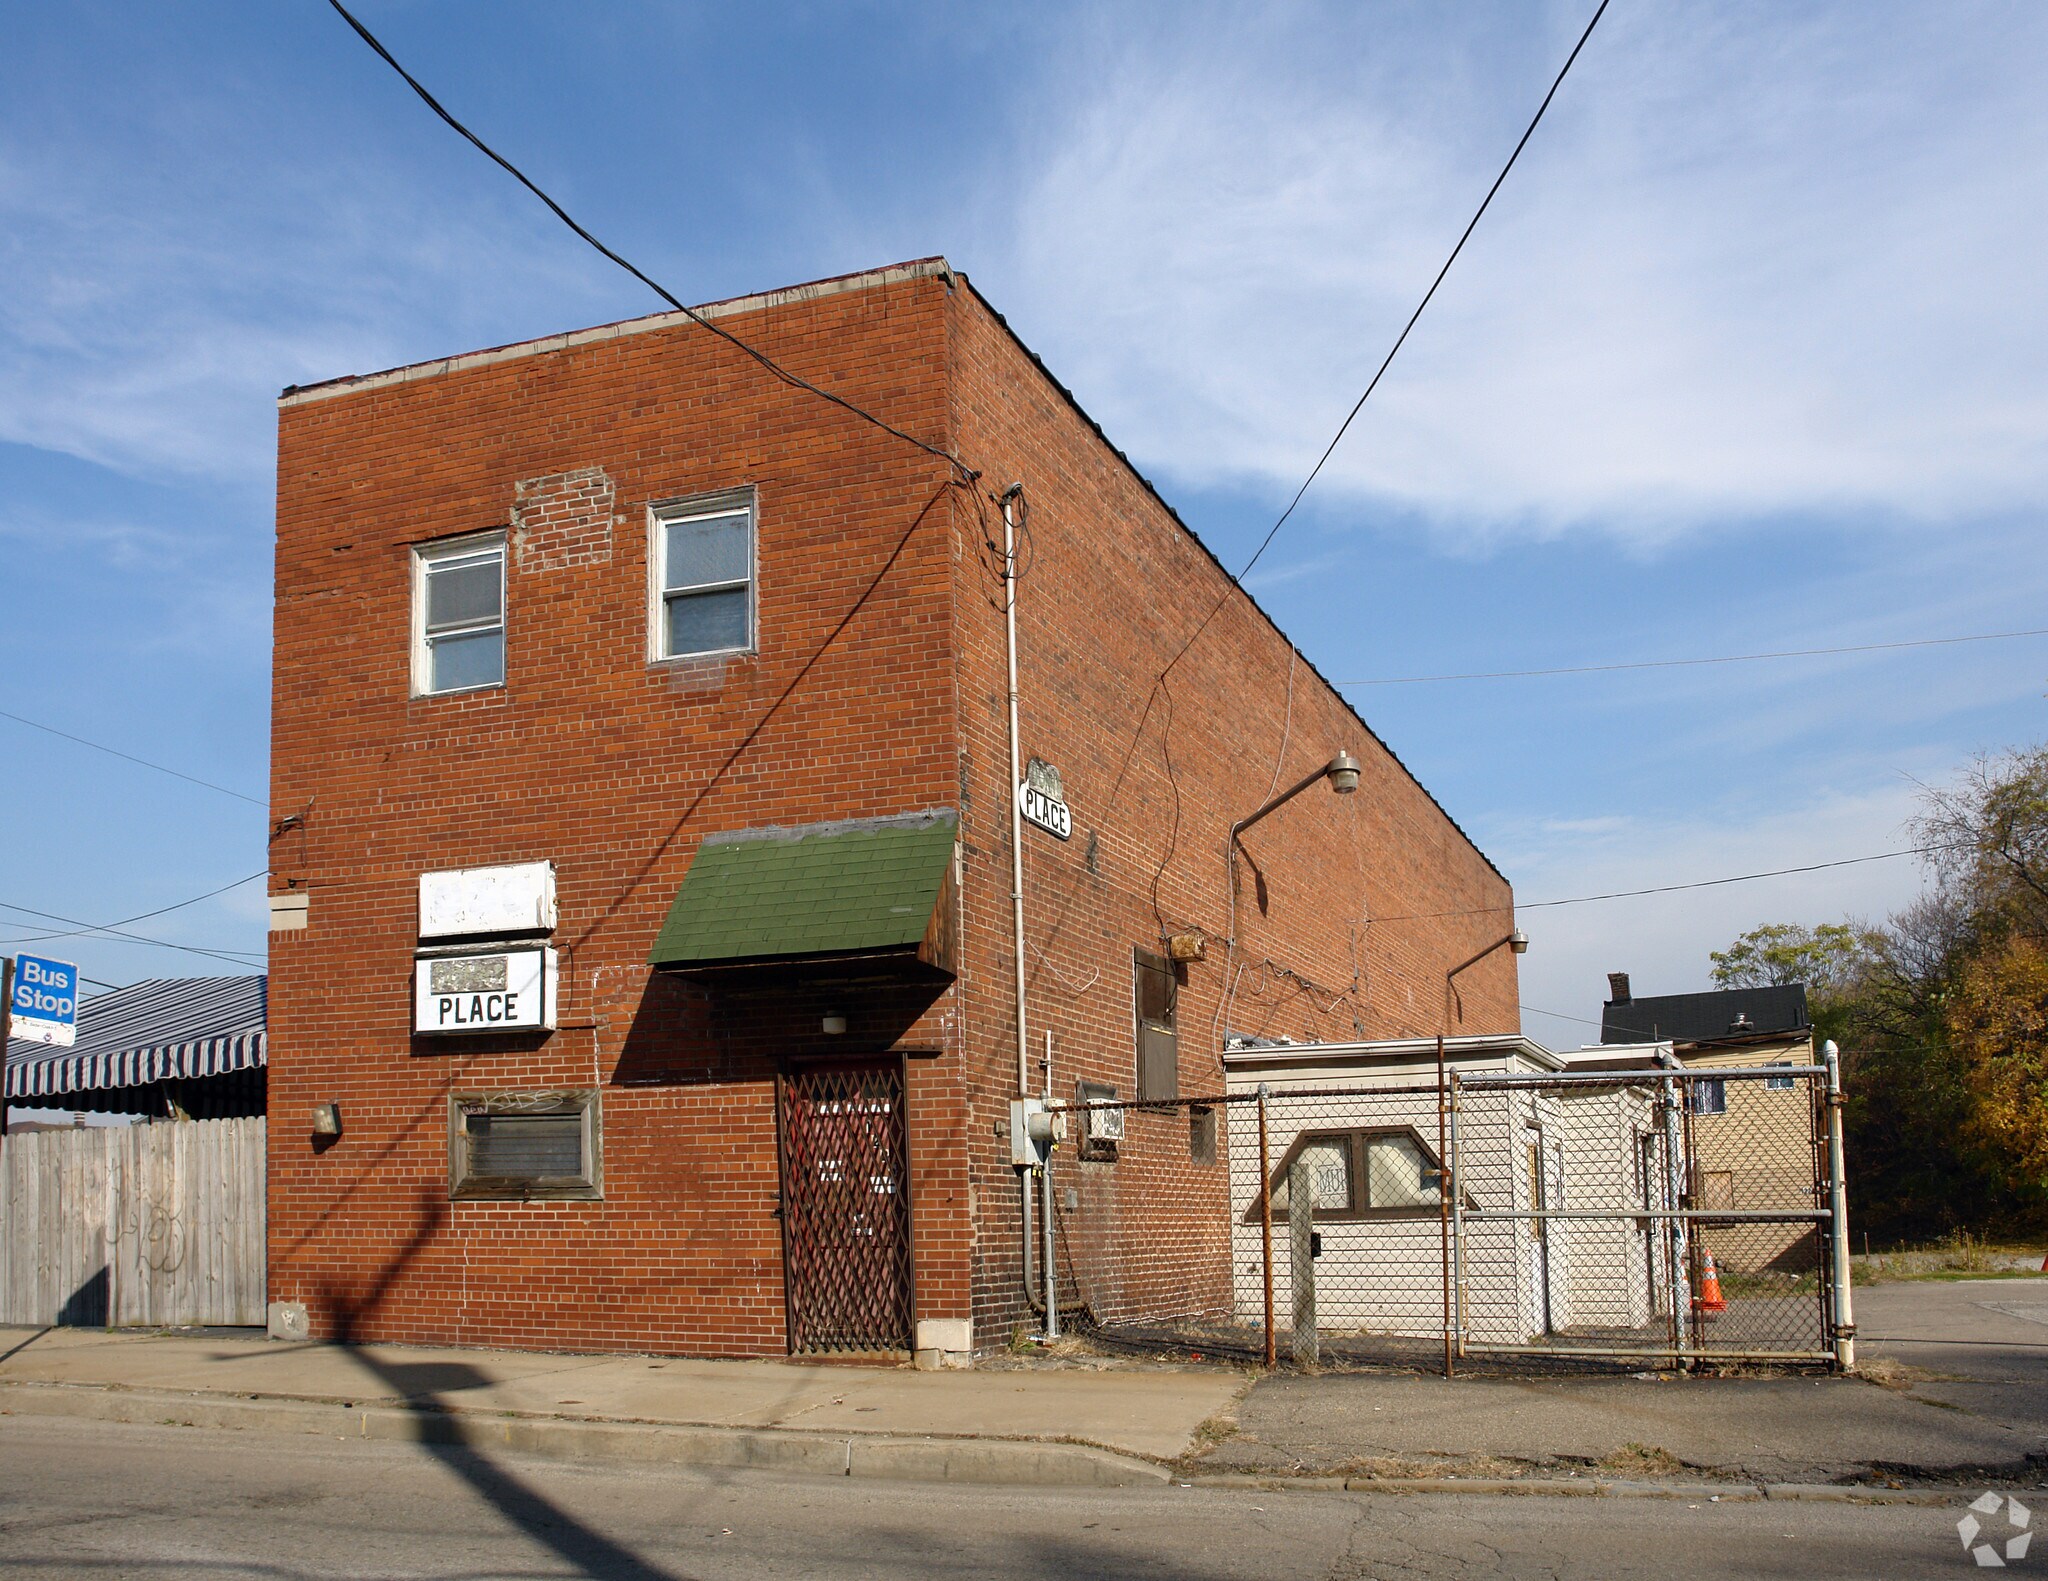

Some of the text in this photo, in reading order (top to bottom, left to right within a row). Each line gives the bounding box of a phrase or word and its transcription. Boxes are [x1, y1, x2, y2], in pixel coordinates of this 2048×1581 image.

[1026, 789, 1067, 834] PLACE
[23, 961, 69, 989] Bus
[16, 985, 73, 1017] Stop
[439, 993, 518, 1025] PLACE
[481, 1089, 563, 1113] KIDS
